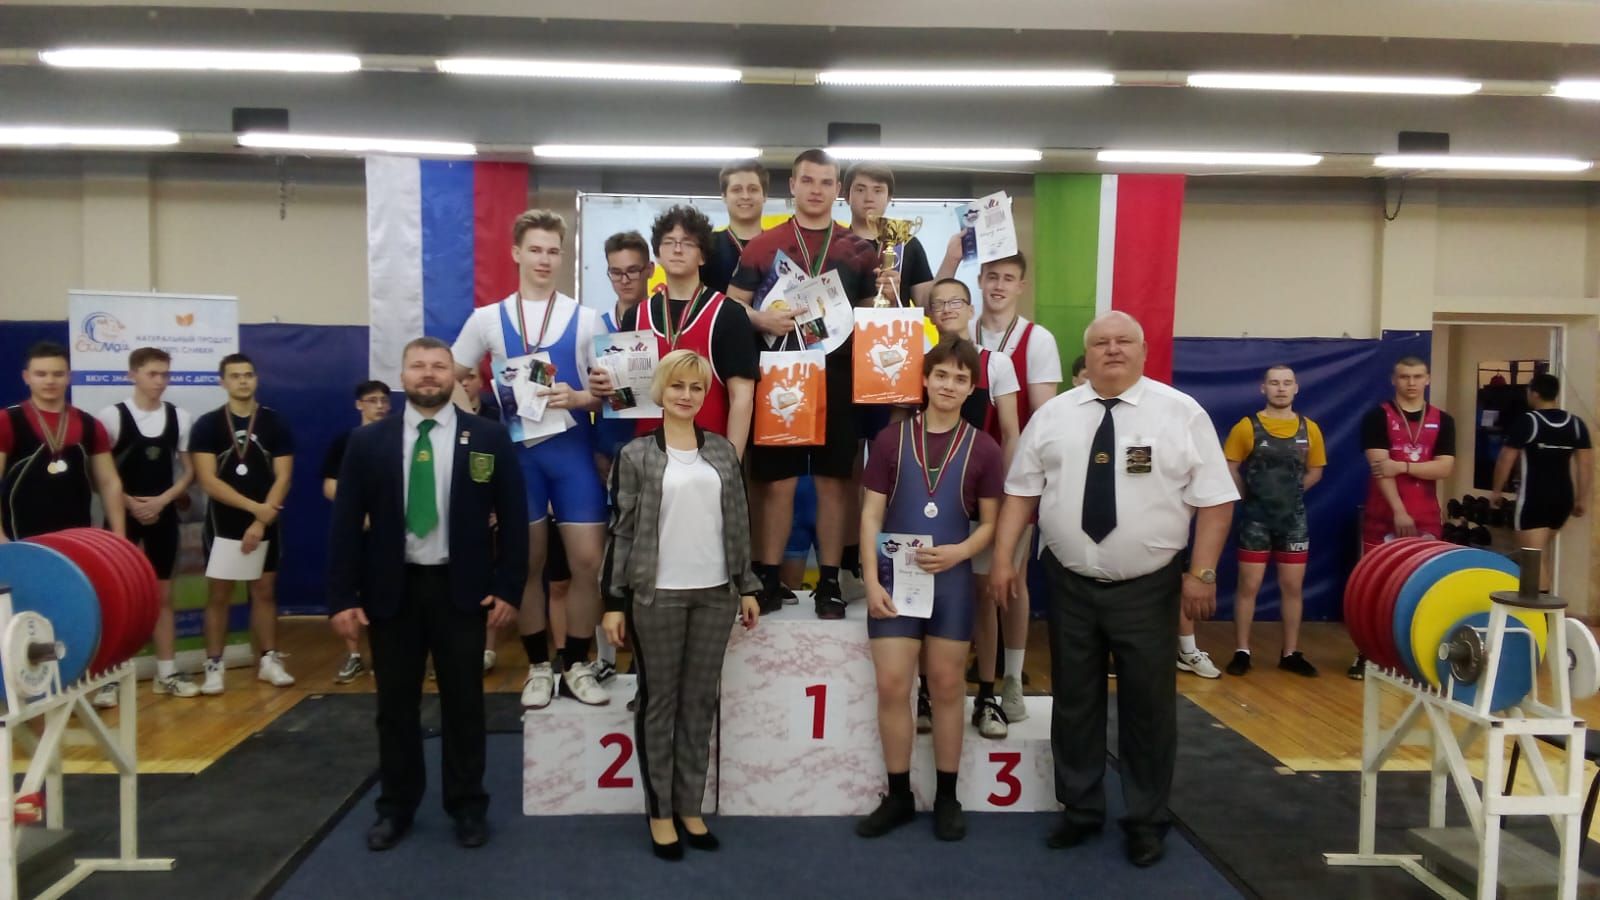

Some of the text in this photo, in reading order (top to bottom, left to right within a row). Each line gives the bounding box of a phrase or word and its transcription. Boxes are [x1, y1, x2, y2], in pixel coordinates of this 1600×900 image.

[136, 335, 234, 344] НАТУРАЛЬНЫЙ ПРОДУКТ
[85, 374, 110, 383] ВКУС
[185, 375, 193, 383] С
[805, 684, 827, 739] 1
[597, 732, 634, 788] 2
[987, 752, 1022, 806] 3
